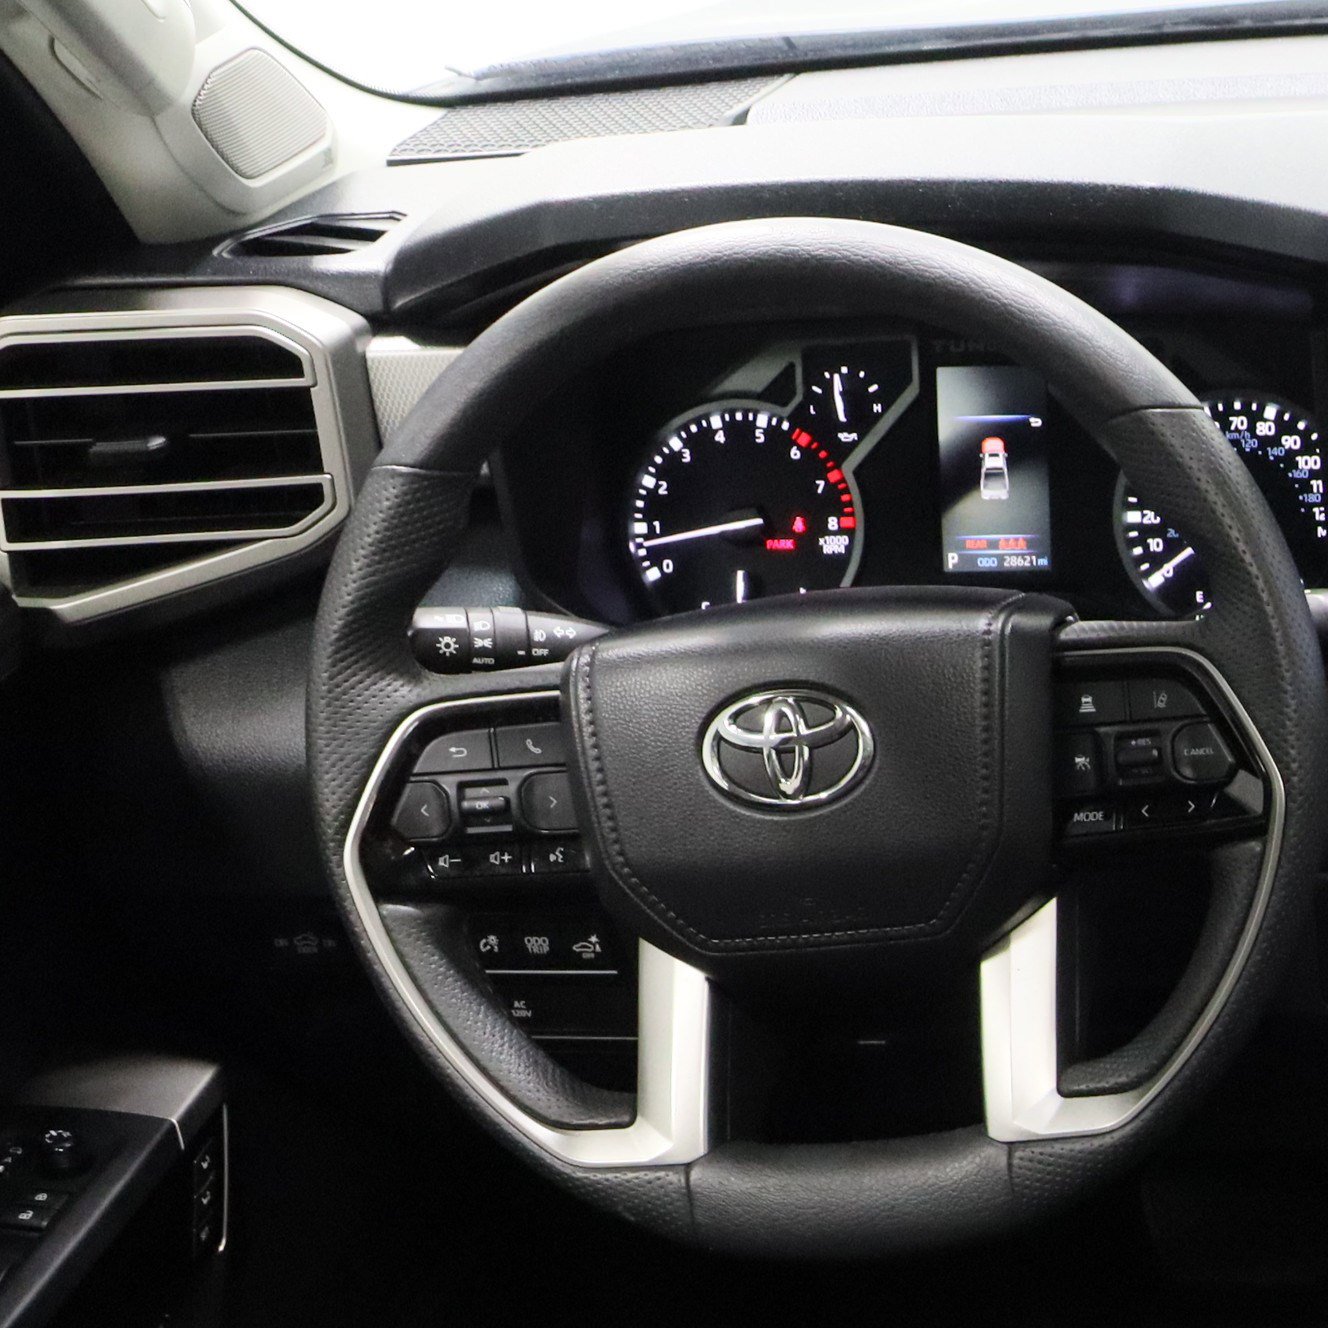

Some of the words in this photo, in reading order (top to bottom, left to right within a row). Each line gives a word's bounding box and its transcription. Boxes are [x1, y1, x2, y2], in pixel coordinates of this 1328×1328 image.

[1228, 416, 1249, 431] 70
[1255, 421, 1276, 436] 80
[713, 431, 726, 445] 4
[754, 429, 766, 444] 5
[1241, 438, 1259, 448] 120
[1280, 435, 1302, 450] 90
[680, 448, 692, 463] 3
[789, 446, 802, 460] 6
[1266, 446, 1286, 456] 140
[1295, 455, 1322, 470] 100
[657, 481, 669, 496] 2
[815, 480, 826, 494] 7
[1303, 493, 1322, 503] 180
[652, 520, 661, 534] 1
[827, 516, 839, 532] 8
[765, 538, 797, 550] PARK
[822, 544, 846, 555] RPM
[1146, 537, 1164, 553] 10
[661, 559, 674, 574] 0
[947, 552, 959, 570] P
[976, 556, 998, 568] ODO
[1003, 555, 1037, 568] 28621
[1195, 590, 1205, 604] E
[531, 648, 550, 657] OFF
[472, 657, 496, 665] AUTO
[1184, 747, 1214, 756] CANCEL
[1073, 810, 1105, 822] MODE
[523, 936, 550, 946] ODO
[526, 945, 551, 954] TRIP
